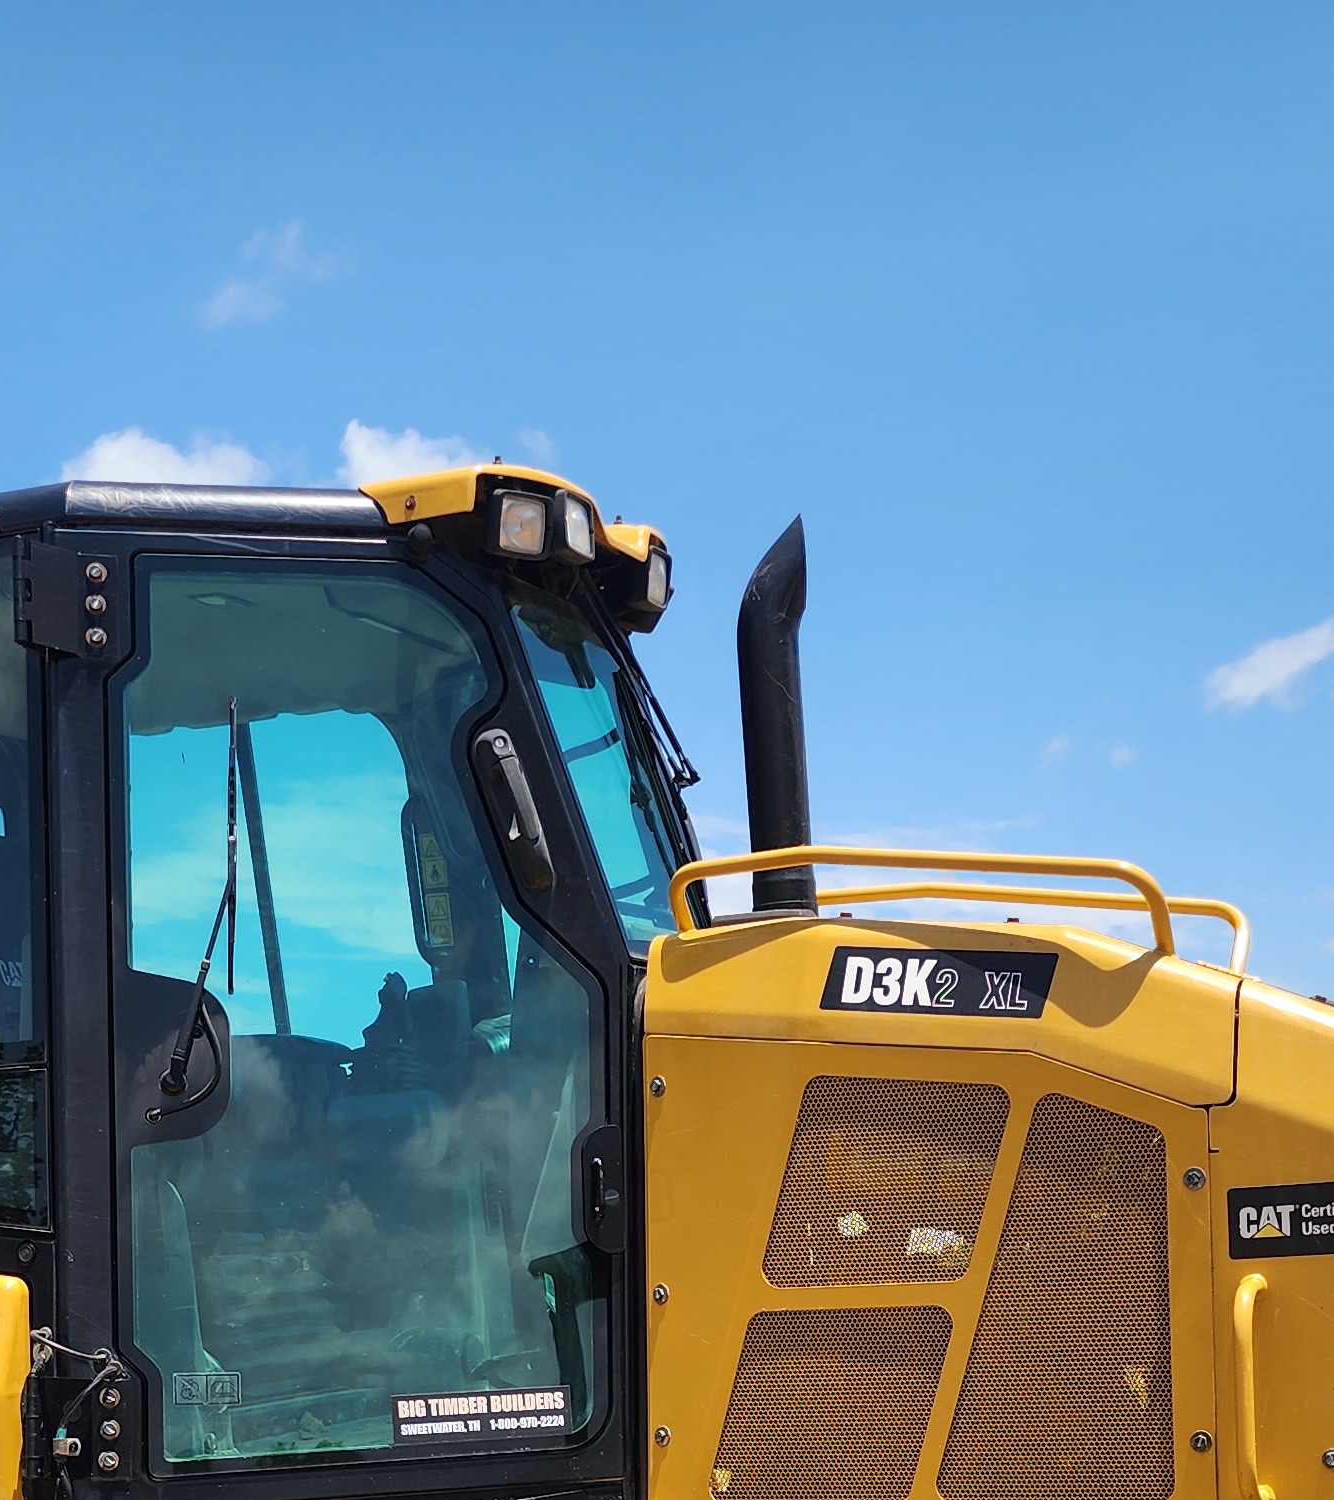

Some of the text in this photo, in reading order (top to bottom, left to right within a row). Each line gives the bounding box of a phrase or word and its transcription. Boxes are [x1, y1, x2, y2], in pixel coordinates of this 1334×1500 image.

[841, 956, 1028, 1010] D3K2 XL
[1239, 1205, 1295, 1239] CAT
[397, 1392, 566, 1418] BIG TIMBER BUILDERS
[400, 1420, 467, 1436] SWEETWATER,
[467, 1419, 481, 1432] TN
